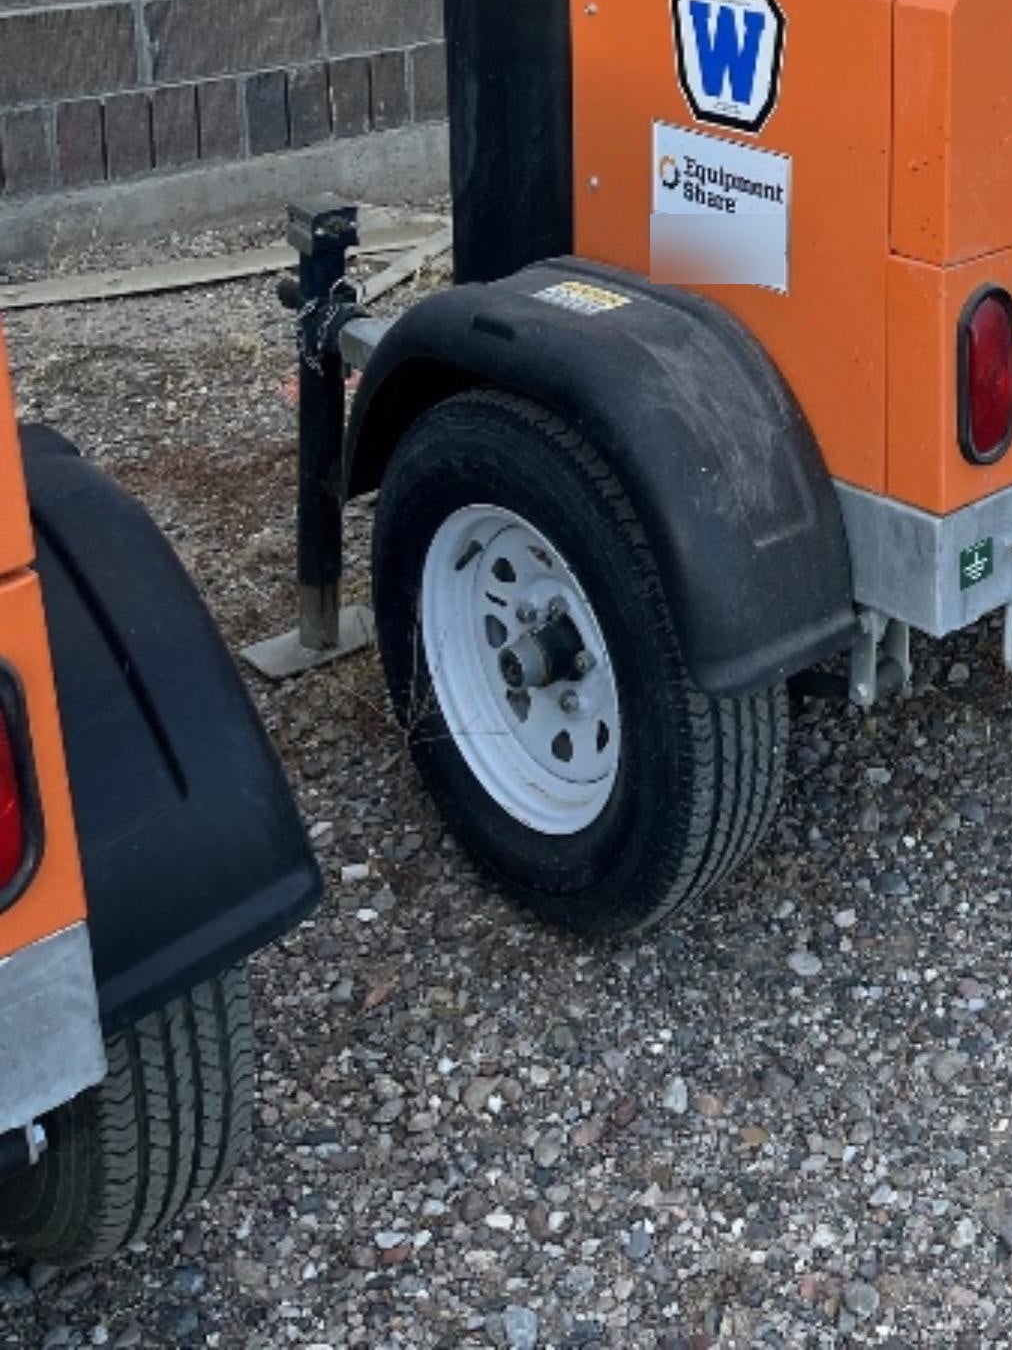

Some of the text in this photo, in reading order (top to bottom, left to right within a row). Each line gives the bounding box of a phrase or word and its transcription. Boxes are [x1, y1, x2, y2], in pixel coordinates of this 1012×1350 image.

[688, 0, 766, 105] W
[683, 155, 785, 204] Equipment
[683, 180, 737, 214] Share
